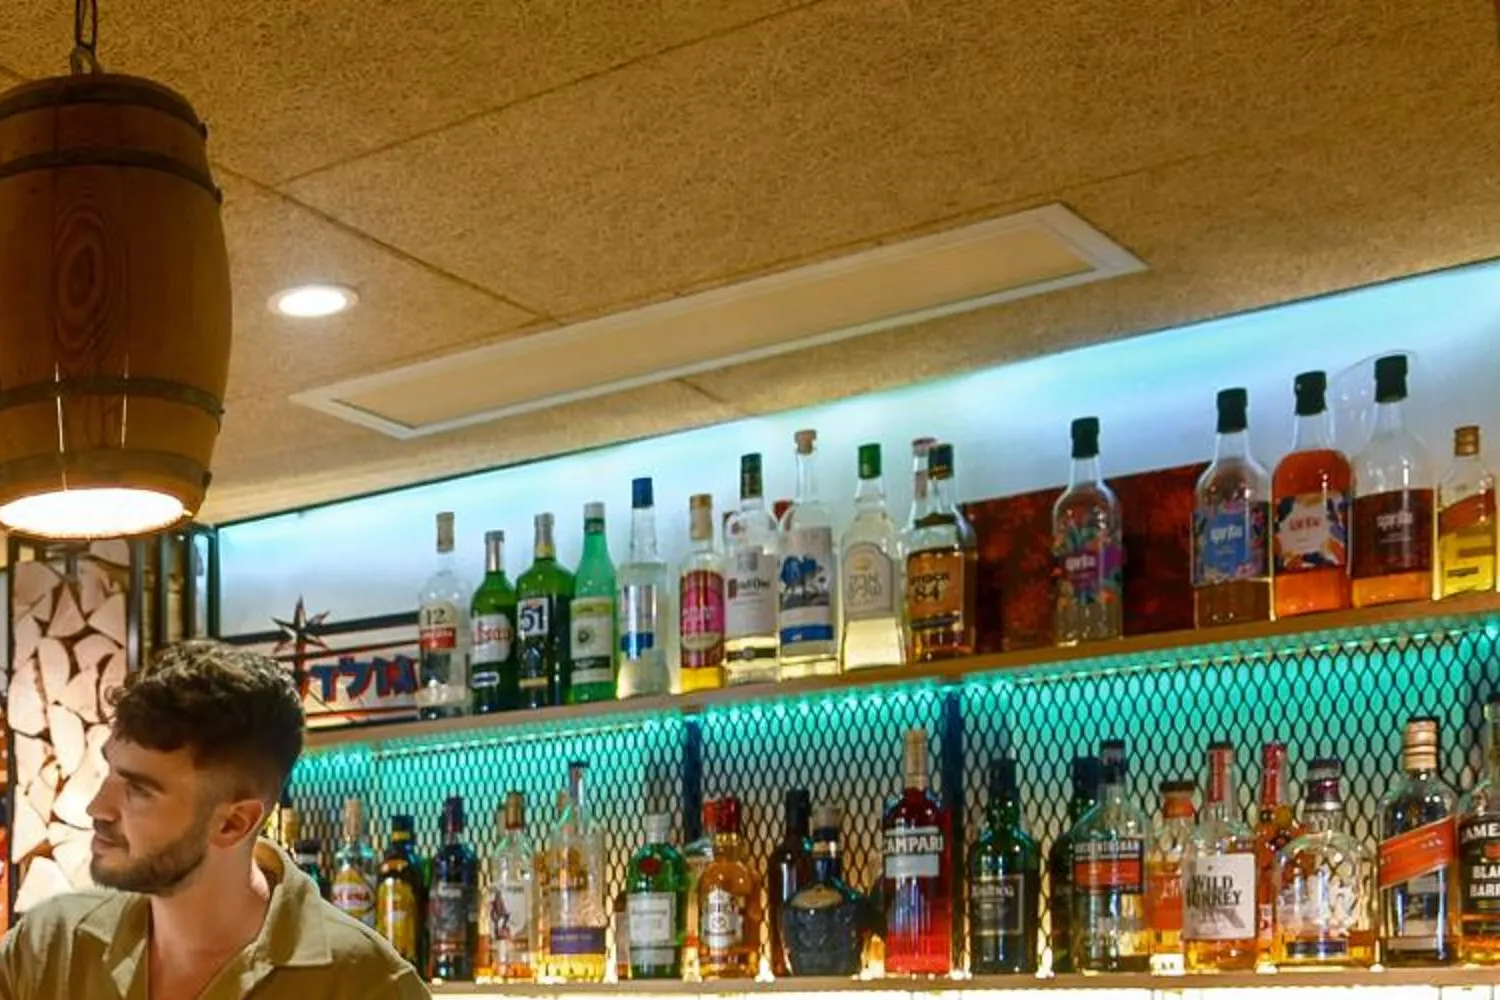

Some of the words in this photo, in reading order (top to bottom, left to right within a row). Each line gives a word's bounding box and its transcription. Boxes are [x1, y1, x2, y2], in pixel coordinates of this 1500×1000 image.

[426, 608, 446, 625] 12
[519, 605, 545, 633] 51
[883, 834, 944, 854] CAMPARI
[1190, 873, 1233, 890] WILD
